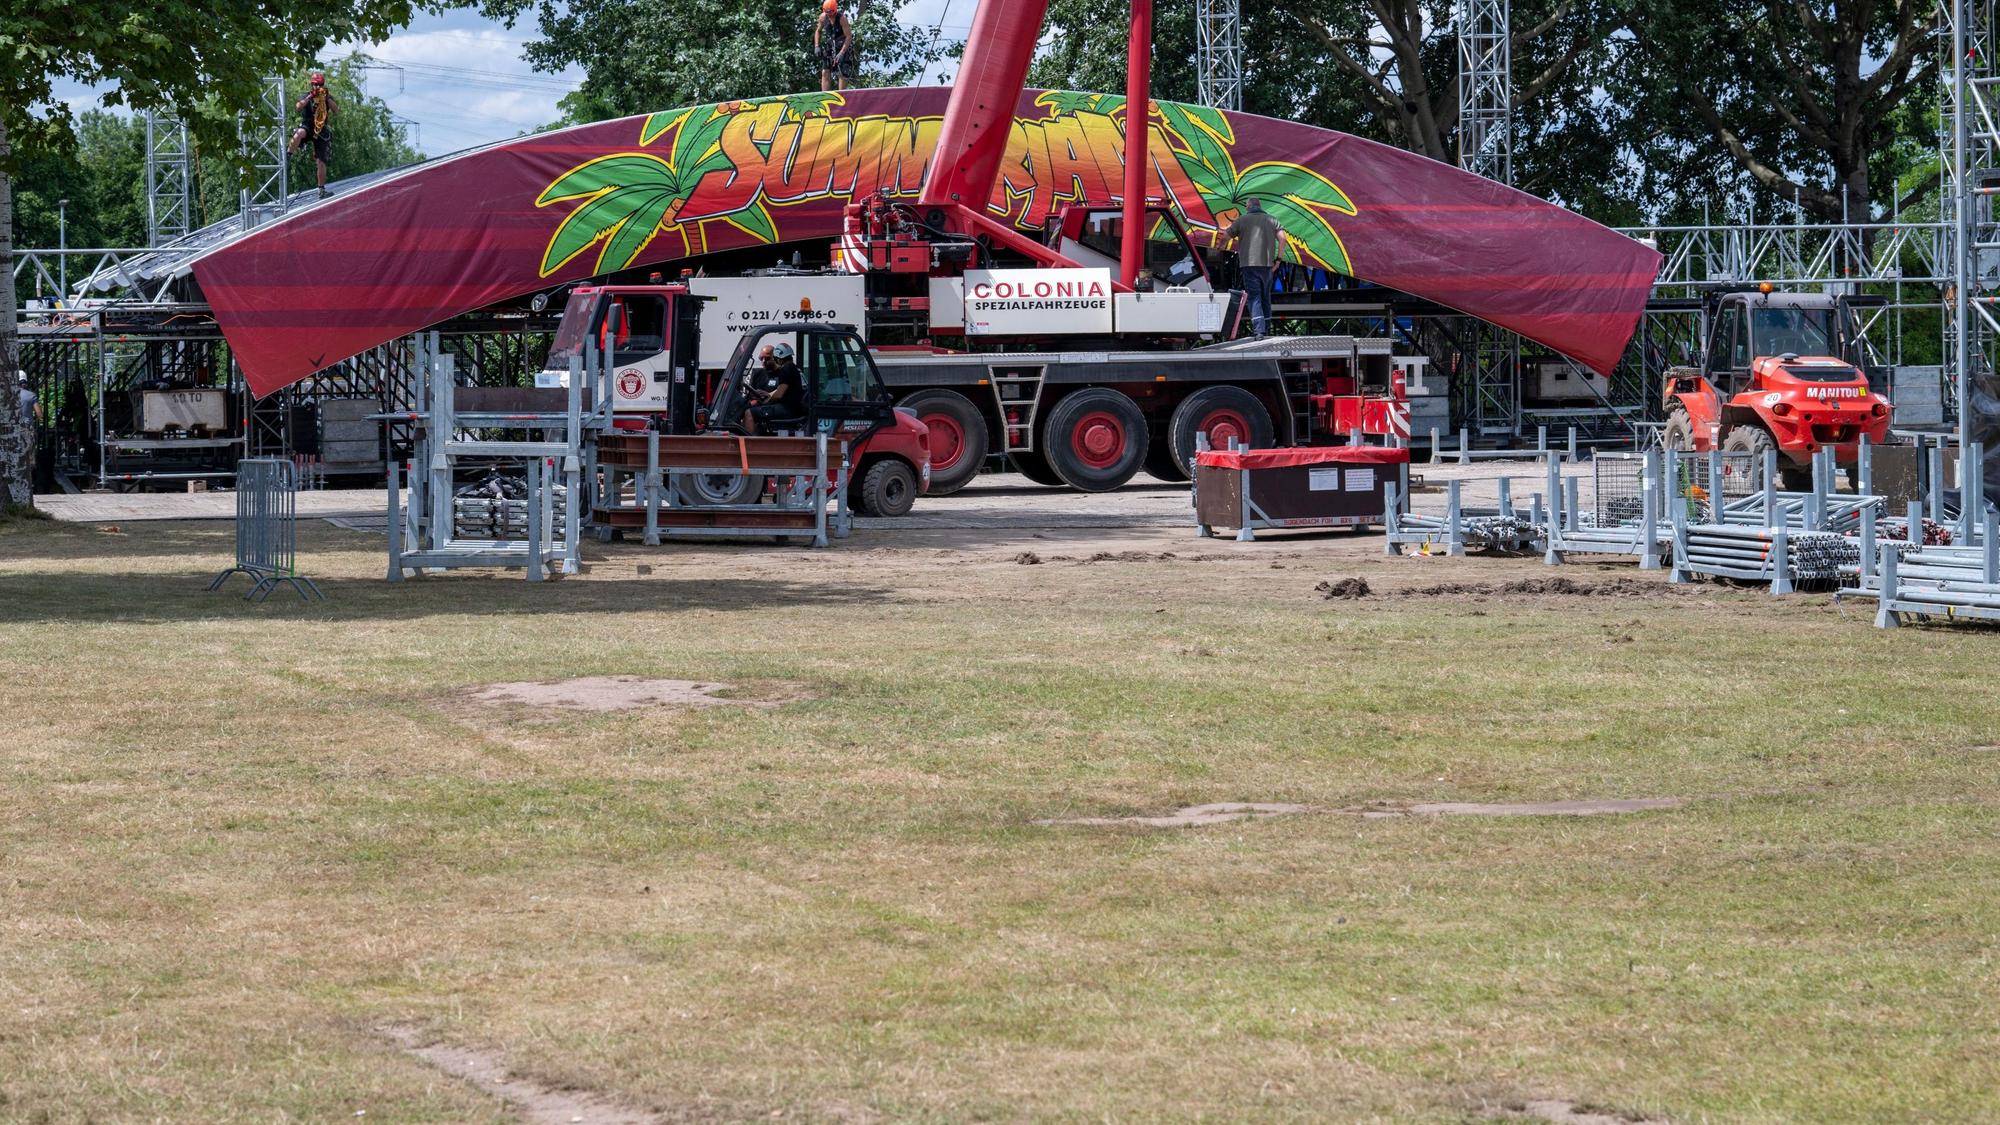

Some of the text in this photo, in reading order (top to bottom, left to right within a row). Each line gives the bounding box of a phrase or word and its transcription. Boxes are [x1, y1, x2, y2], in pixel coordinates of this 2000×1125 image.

[974, 281, 1106, 299] COLONIA
[975, 300, 1107, 311] SPEZIALFAHRZEUGE
[783, 309, 836, 320] 95686-0
[1806, 386, 1859, 398] MANITOU
